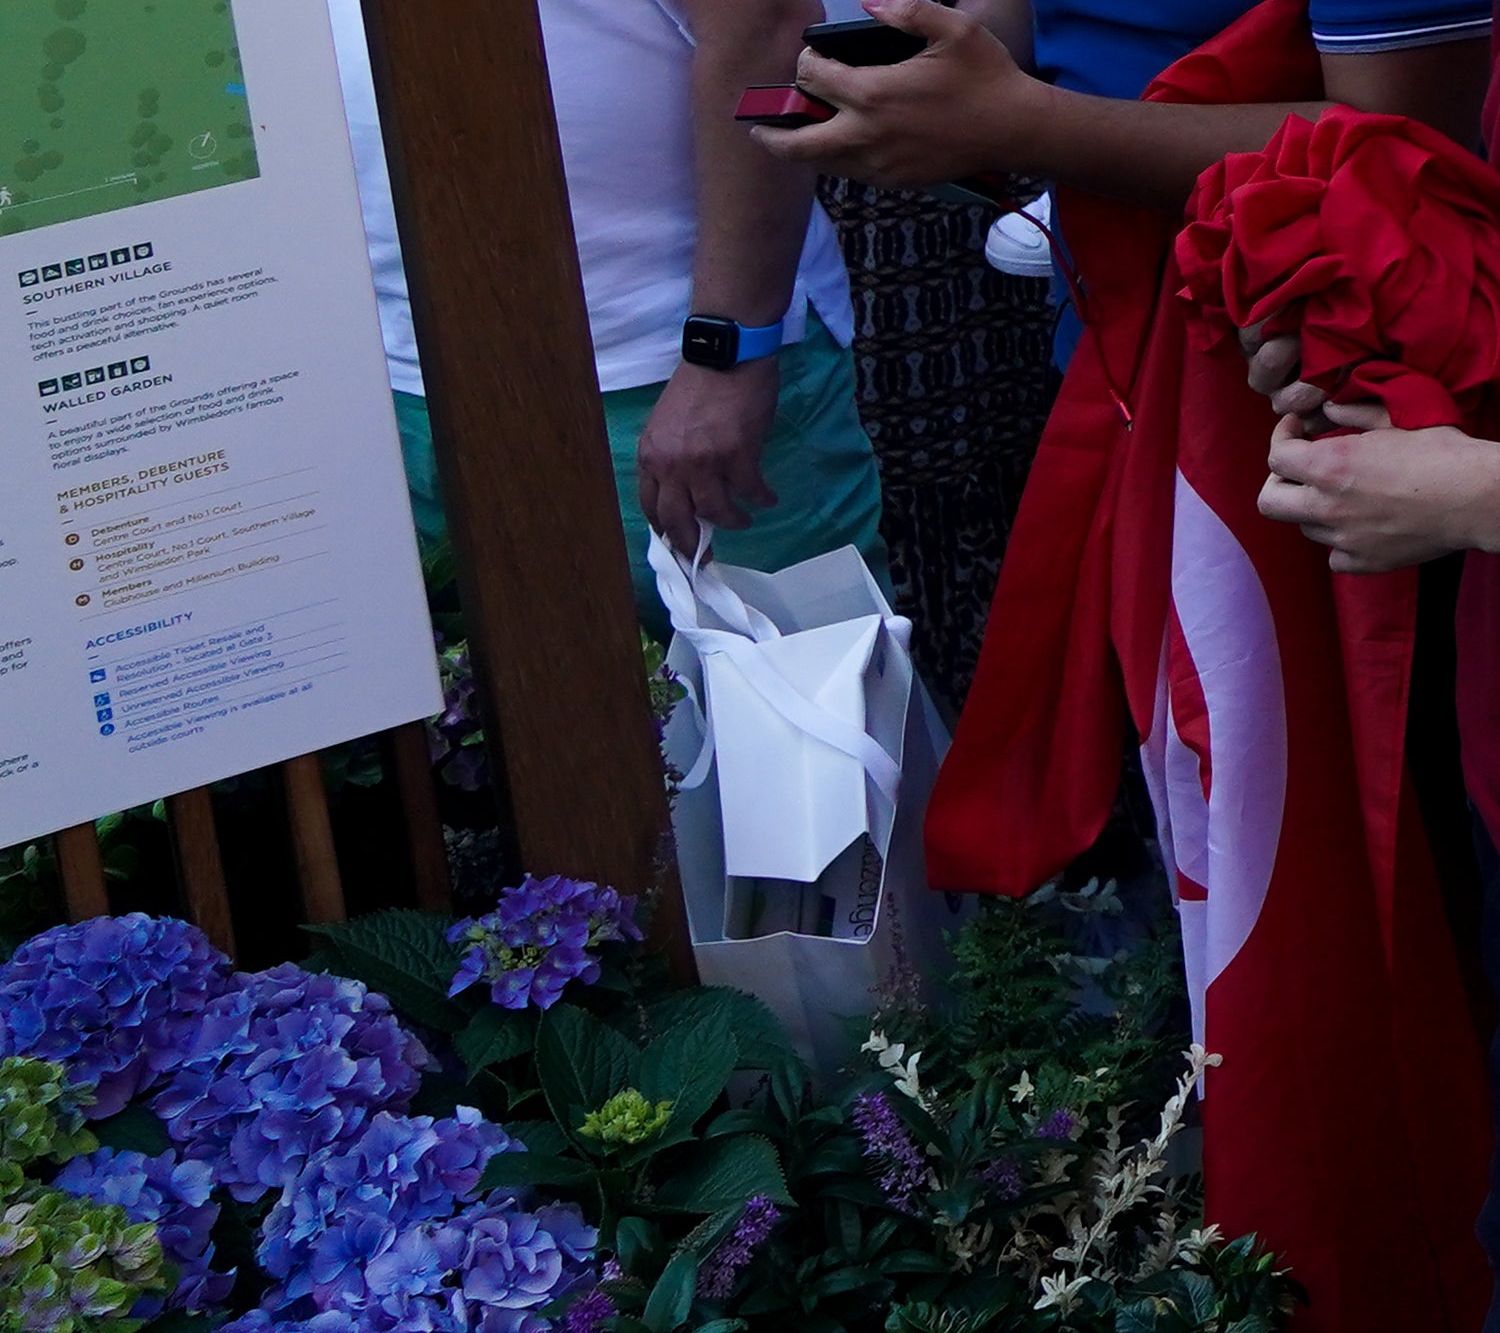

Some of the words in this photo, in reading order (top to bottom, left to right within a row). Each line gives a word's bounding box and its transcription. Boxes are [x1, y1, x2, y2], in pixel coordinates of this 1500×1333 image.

[22, 276, 104, 305] SOUTHERN
[110, 260, 172, 284] VILLAGE
[28, 319, 50, 331] This
[52, 307, 97, 326] bustling
[100, 302, 122, 314] part
[124, 298, 136, 307] of
[138, 293, 156, 304] the
[159, 282, 203, 299] Grounds
[206, 277, 225, 287] has
[29, 328, 55, 341] food
[57, 323, 78, 334] and
[81, 315, 109, 328] drink
[157, 299, 175, 310] fan
[177, 286, 235, 306] experience
[31, 339, 56, 352] tech
[58, 325, 111, 345] activation
[113, 320, 135, 331] and
[202, 297, 229, 311] quiet
[231, 291, 258, 302] room
[33, 347, 64, 361] offers
[75, 333, 121, 353] peaceful
[42, 390, 106, 414] WALLED
[111, 373, 173, 398] GARDEN
[47, 431, 57, 439] A
[58, 418, 107, 436] beautiful
[109, 413, 131, 425] part
[135, 408, 146, 416] of
[149, 403, 167, 413] the
[169, 391, 214, 408] Grounds
[216, 380, 257, 397] offering
[269, 371, 300, 383] space
[49, 442, 60, 450] to
[63, 434, 92, 447] enjoy
[106, 423, 131, 435] wide
[134, 403, 182, 428] selection
[184, 406, 195, 414] of
[198, 399, 222, 411] food
[225, 394, 245, 405] and
[247, 387, 273, 398] drink
[50, 444, 92, 461] options
[94, 427, 156, 449] surrounded
[159, 422, 172, 432] by
[245, 395, 284, 410] famous
[52, 457, 81, 470] floral
[57, 473, 134, 502] MEMBERS,
[138, 449, 226, 480] DEBENTURE
[59, 504, 69, 514] &
[74, 478, 168, 510] HOSPITALITY
[174, 462, 230, 484] GUESTS
[91, 515, 150, 537] Debenture
[131, 523, 161, 536] Court
[164, 517, 185, 527] and
[213, 501, 243, 516] Court
[231, 517, 279, 535] Southern
[95, 540, 155, 562] Hospitality
[187, 546, 211, 560] Park
[101, 579, 153, 598] Members
[85, 611, 193, 649] ACCESSIBILITY
